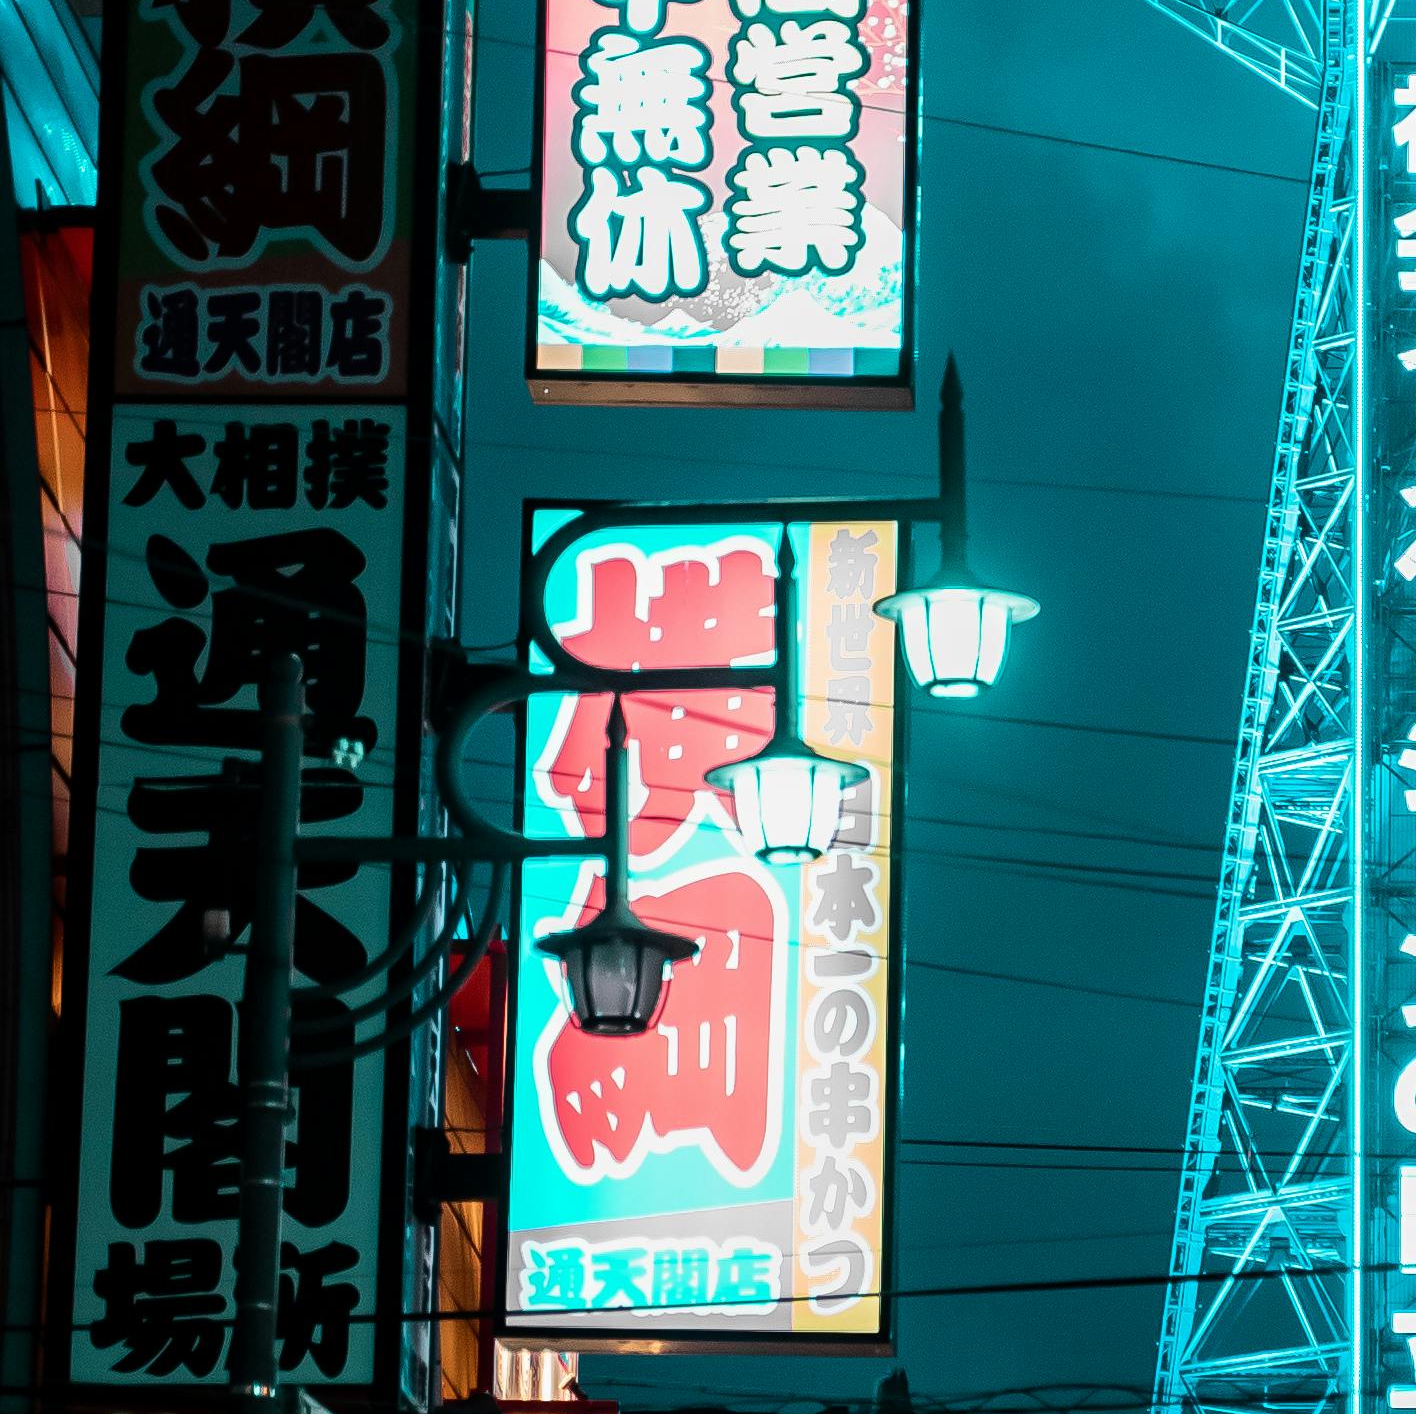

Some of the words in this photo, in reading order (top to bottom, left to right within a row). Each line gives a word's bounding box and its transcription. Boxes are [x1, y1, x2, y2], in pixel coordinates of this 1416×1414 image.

[138, 287, 389, 381] 通天閣店
[121, 418, 393, 512] 大相撲
[826, 527, 880, 748] 新世界
[106, 525, 379, 1232] 通天閣
[806, 762, 882, 1317] 日本一の串かつ
[527, 1239, 774, 1315] 通天閣店
